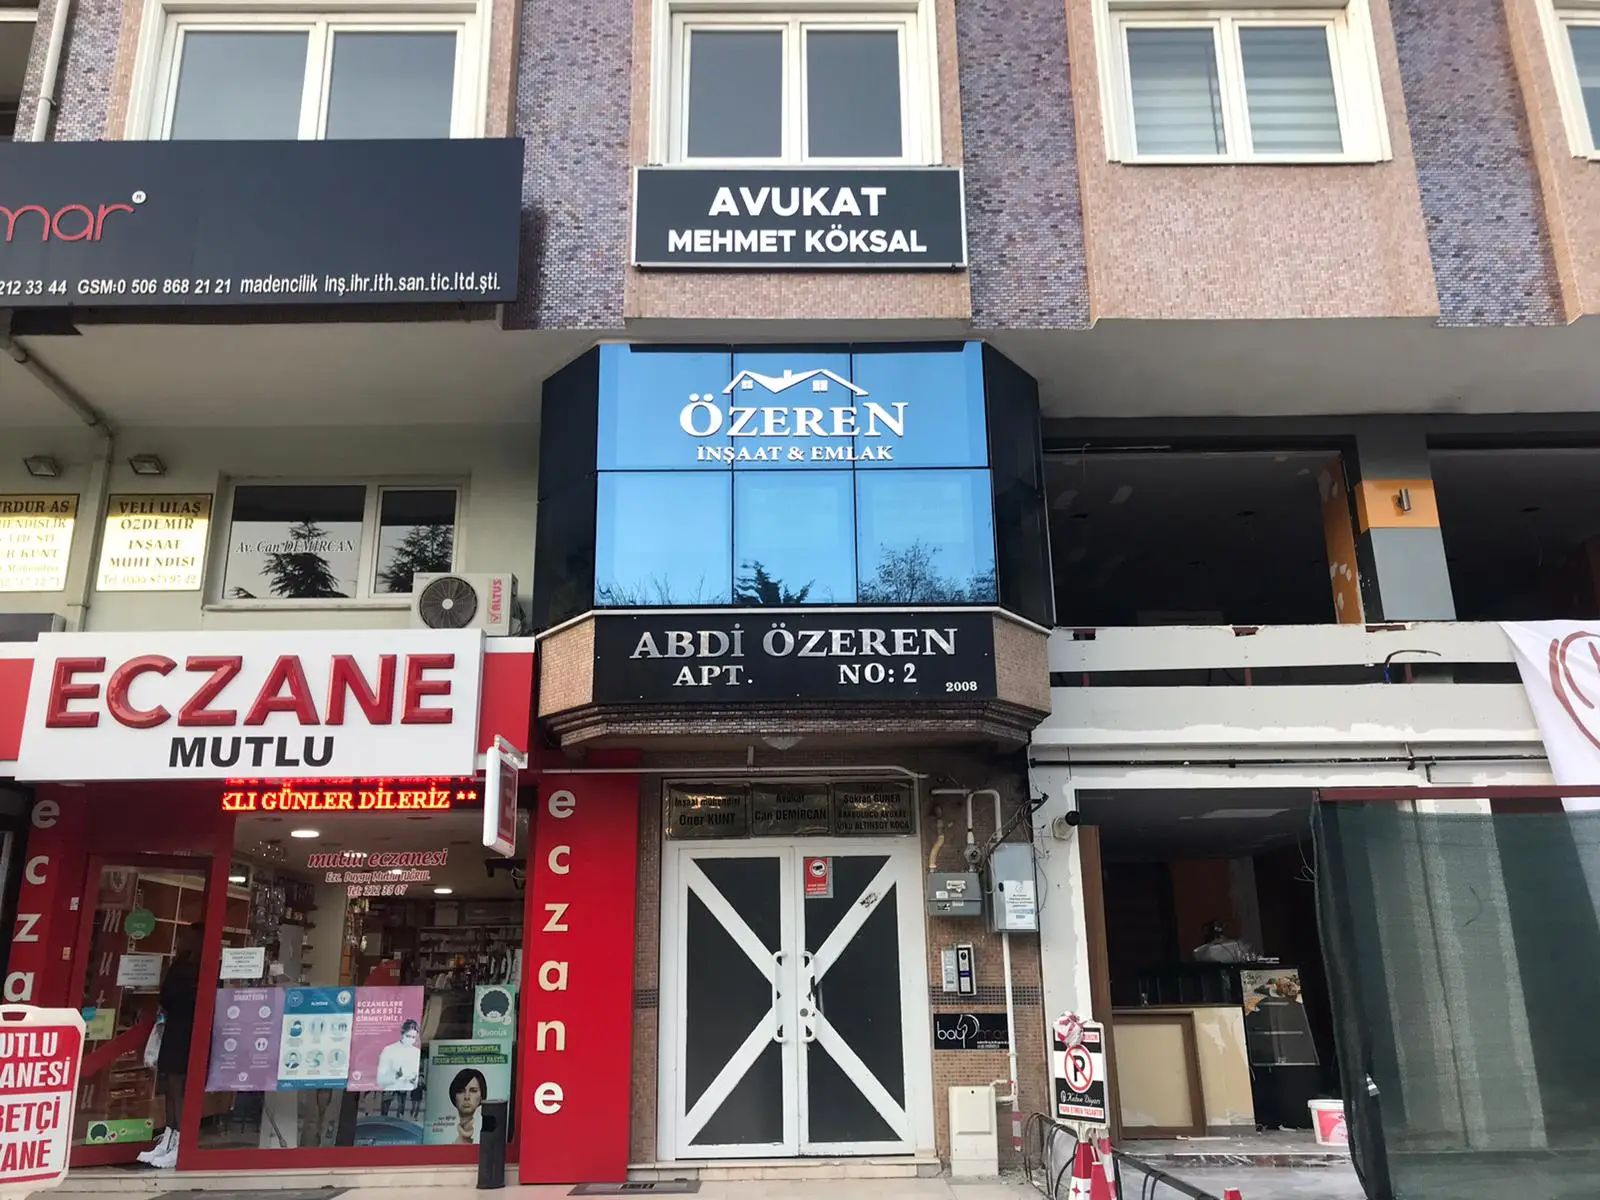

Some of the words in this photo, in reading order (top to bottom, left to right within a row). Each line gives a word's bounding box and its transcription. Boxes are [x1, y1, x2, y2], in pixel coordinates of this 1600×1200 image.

[708, 187, 886, 216] AVUKAT
[668, 229, 796, 252] MEHMET
[805, 224, 927, 253] KÖKSAL
[25, 280, 43, 294] 33
[48, 280, 67, 294] 44
[131, 279, 157, 293] 506
[163, 278, 190, 293] 868
[194, 278, 211, 293] 21
[215, 278, 232, 293] 21
[240, 273, 318, 293] madencilik
[679, 393, 909, 438] ÖZEREN
[788, 447, 805, 461] &
[811, 446, 894, 461] EMLAK
[257, 541, 280, 552] Can
[630, 623, 744, 659] ABDİ
[763, 622, 958, 658] ÖZEREN
[45, 654, 455, 729] ECZANE
[673, 664, 753, 687] APT.
[838, 662, 895, 685] NO:
[903, 663, 917, 684] 2
[945, 680, 978, 693] 2008
[168, 736, 335, 768] MUTLU
[262, 787, 354, 810] GÜNLER
[358, 787, 451, 810] DİLERİZ
[707, 812, 736, 826] KUNT
[755, 810, 773, 821] Can
[308, 850, 364, 868] mutlu
[368, 848, 448, 867] eczanesi
[532, 788, 577, 1114] eczane
[0, 1139, 53, 1172] ANE
